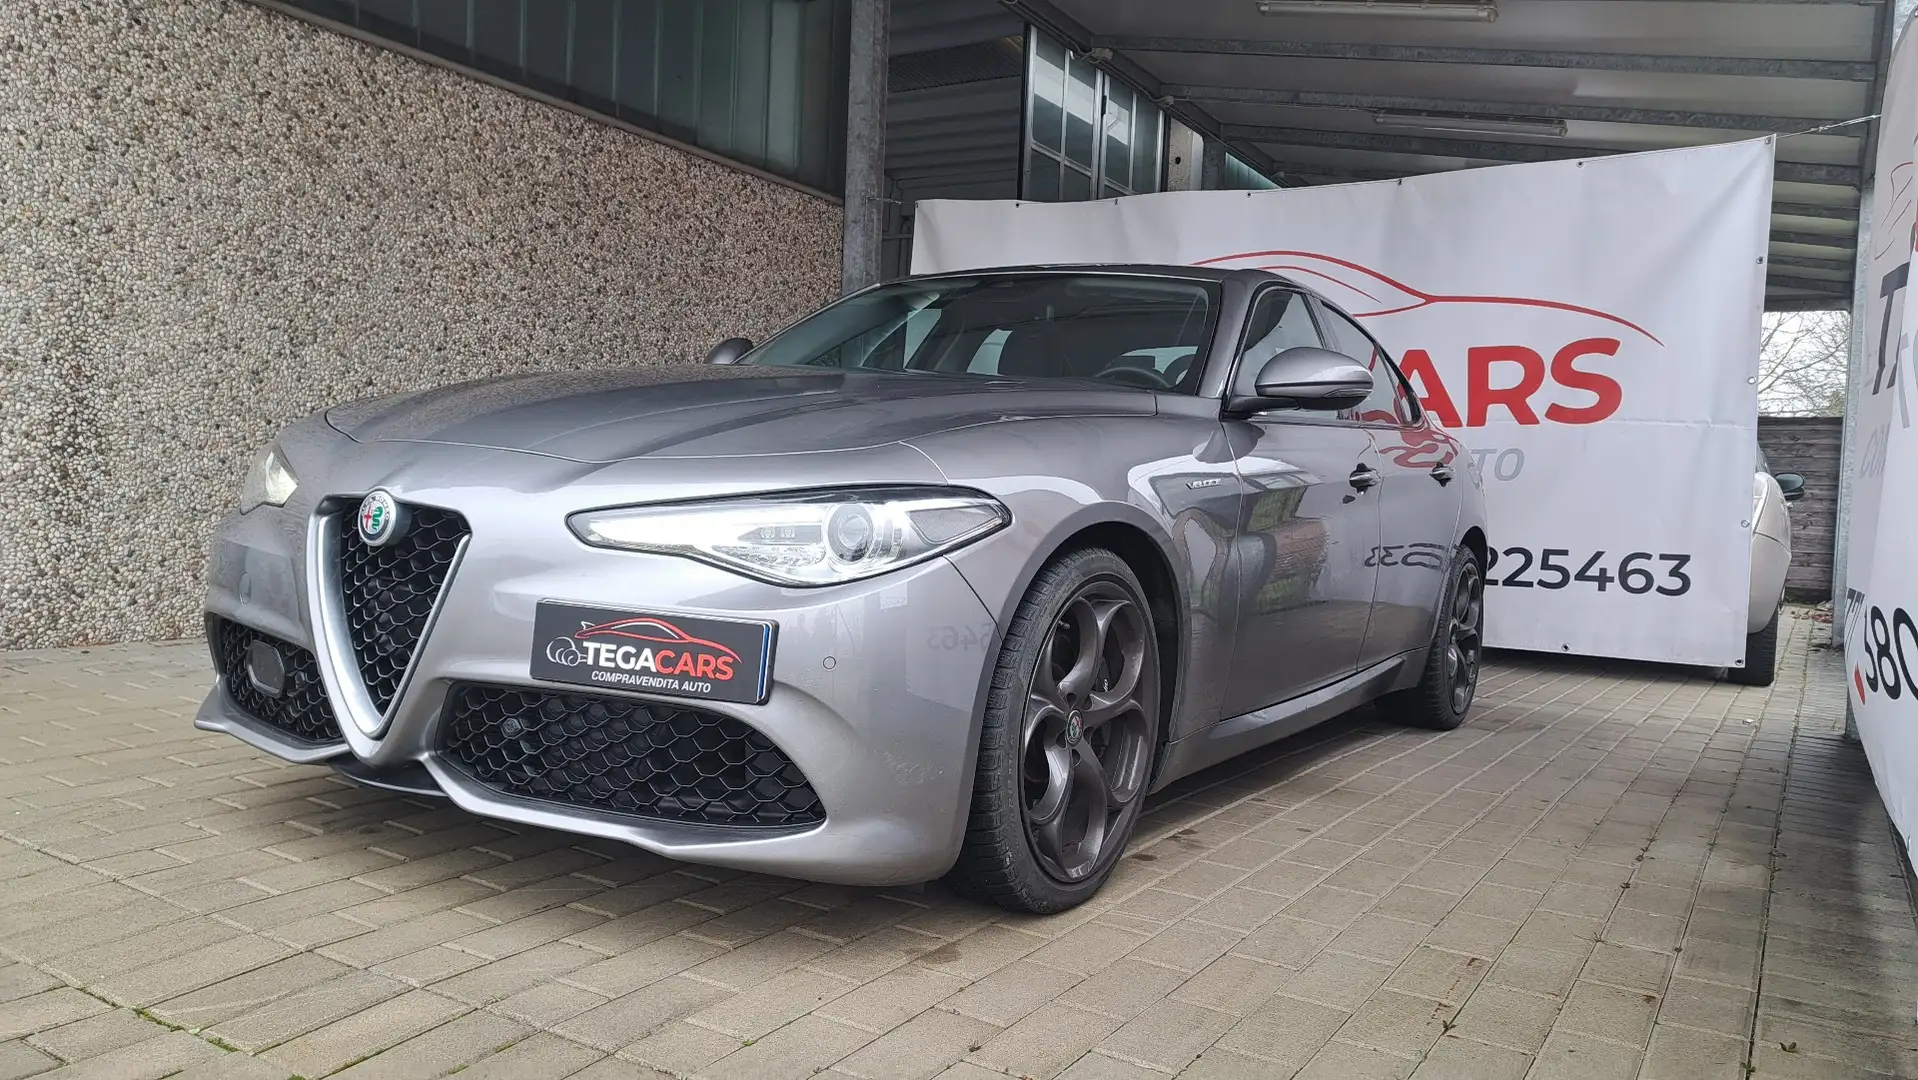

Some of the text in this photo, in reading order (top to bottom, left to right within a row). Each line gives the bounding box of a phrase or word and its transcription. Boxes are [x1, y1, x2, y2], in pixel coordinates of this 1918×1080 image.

[582, 640, 734, 681] TEGACARS
[591, 670, 712, 694] COMPRAVENDITA AUTO
